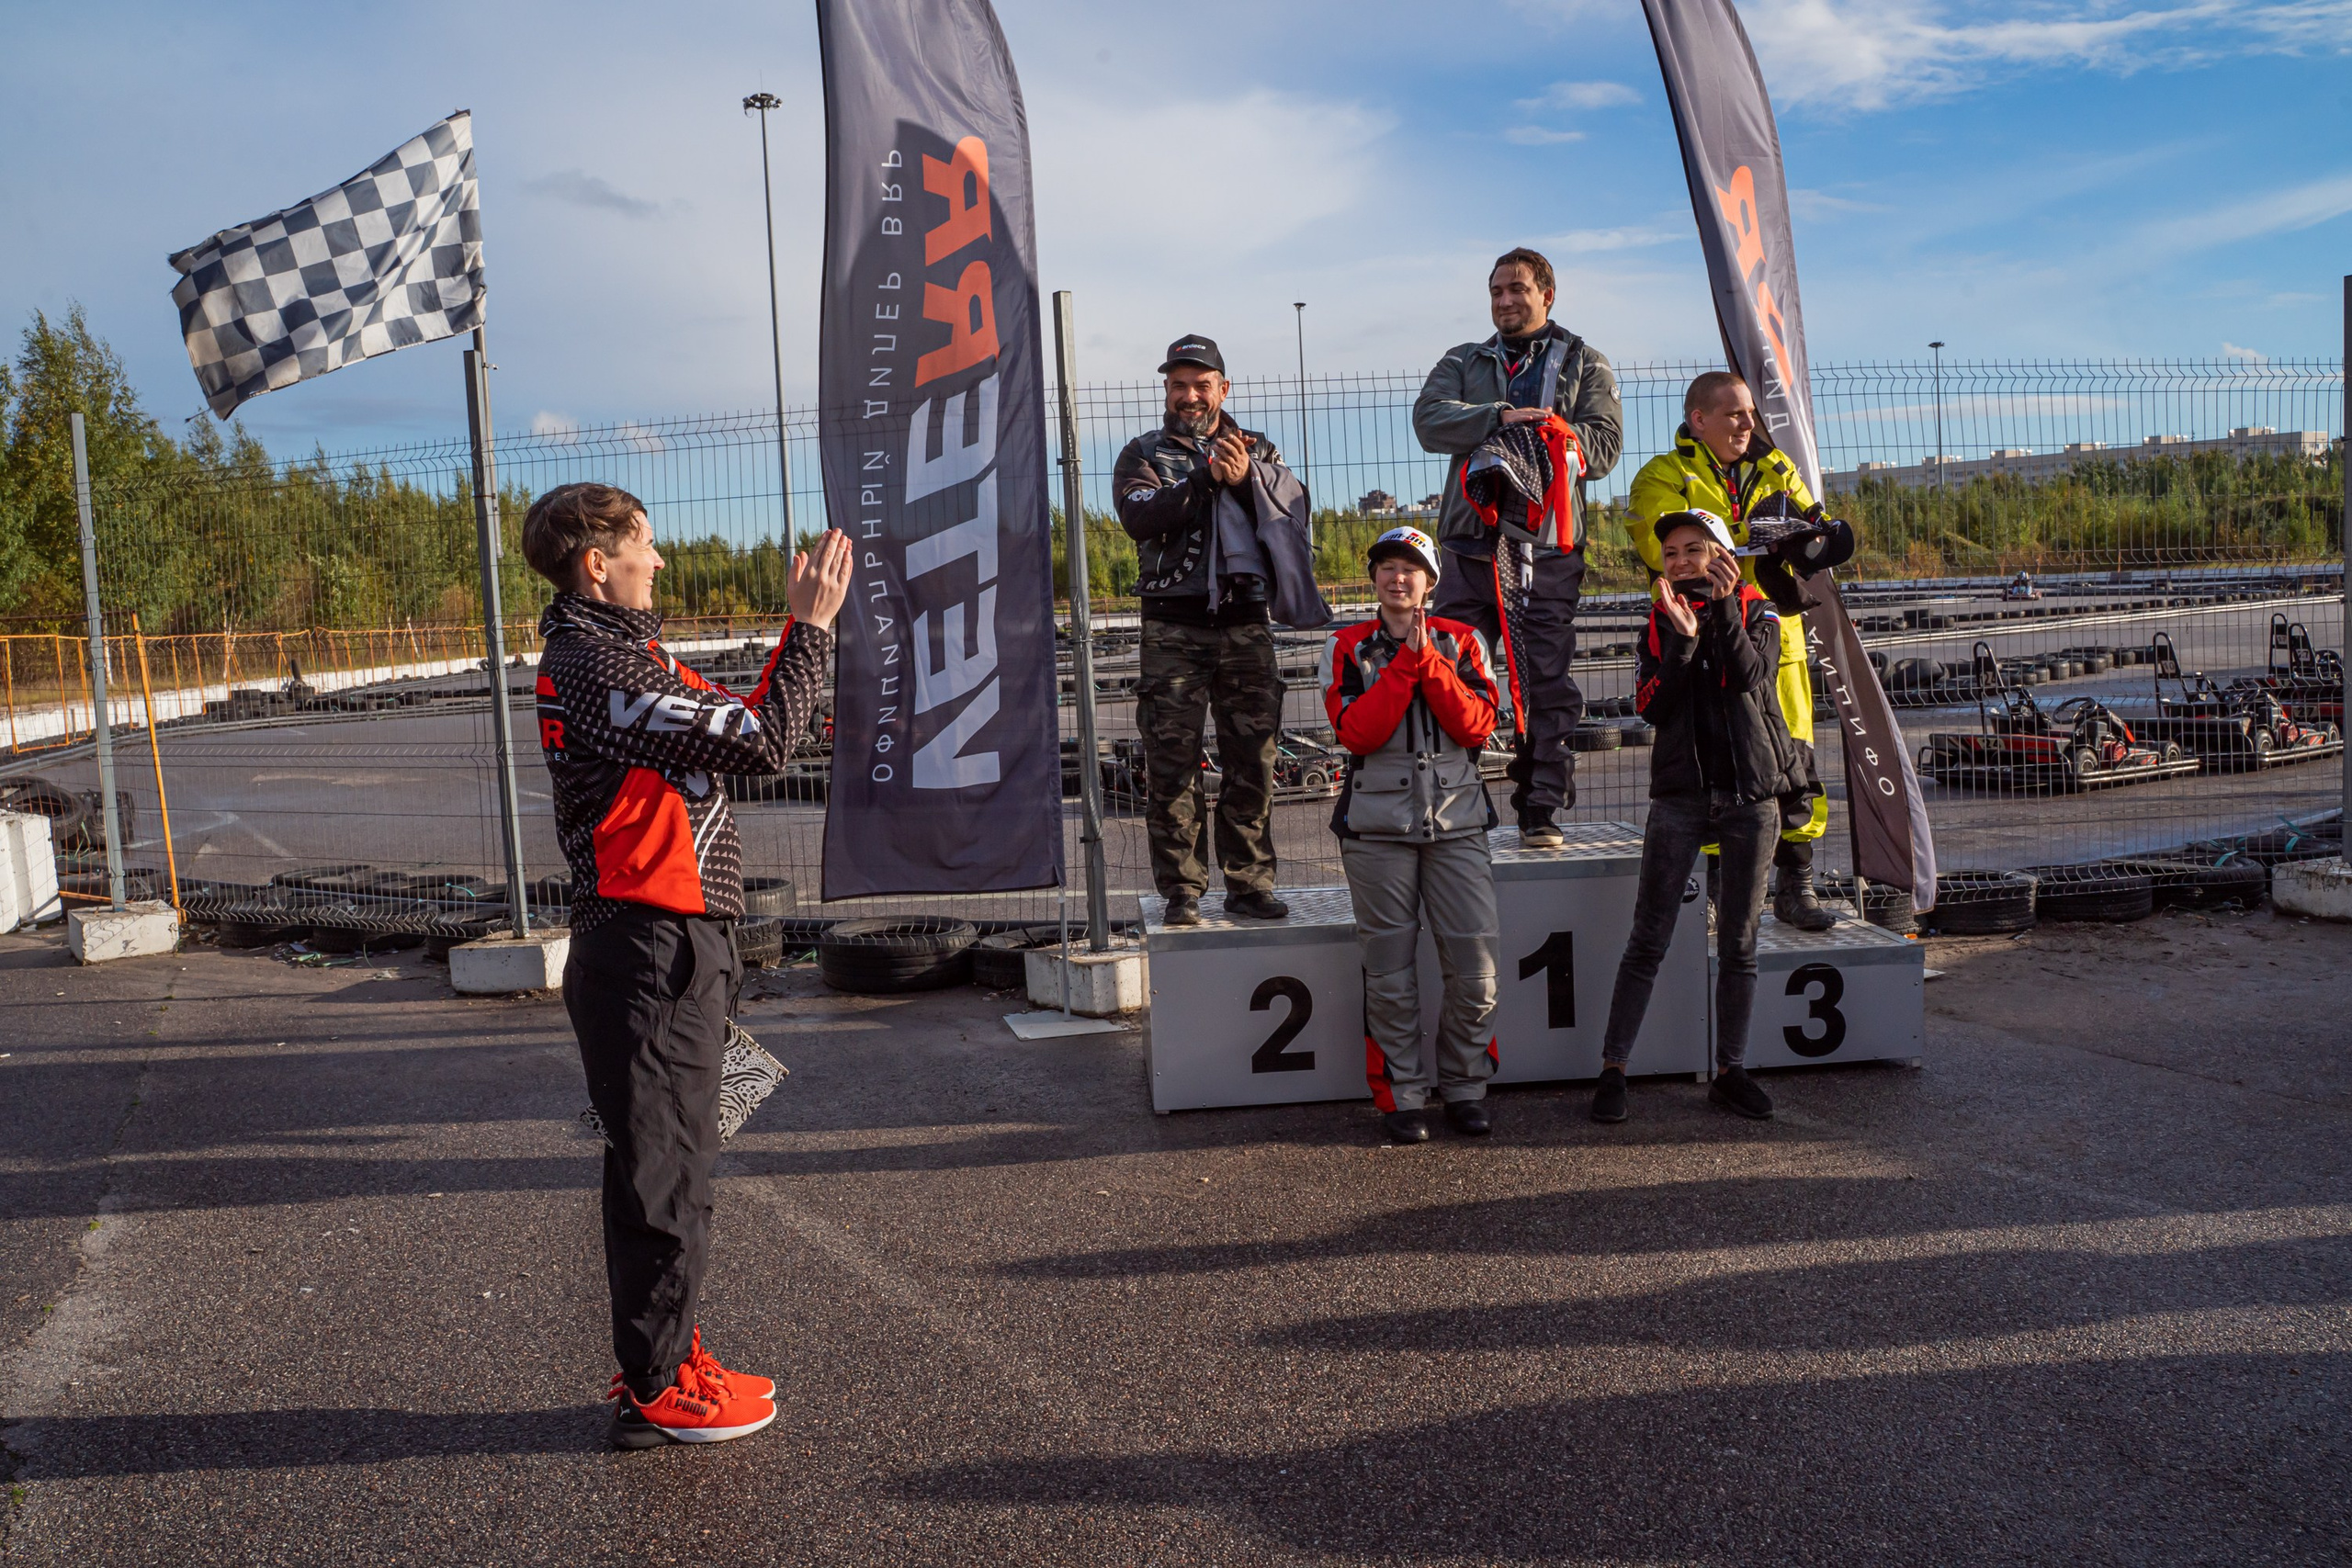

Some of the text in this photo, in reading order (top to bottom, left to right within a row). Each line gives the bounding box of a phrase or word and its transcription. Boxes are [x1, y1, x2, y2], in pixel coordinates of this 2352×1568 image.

[1146, 529, 1202, 590] RUSSIA
[1250, 976, 1315, 1074] 2
[1519, 931, 1575, 1029] 1
[1783, 963, 1846, 1057] 3
[673, 1397, 707, 1417] PUMA
